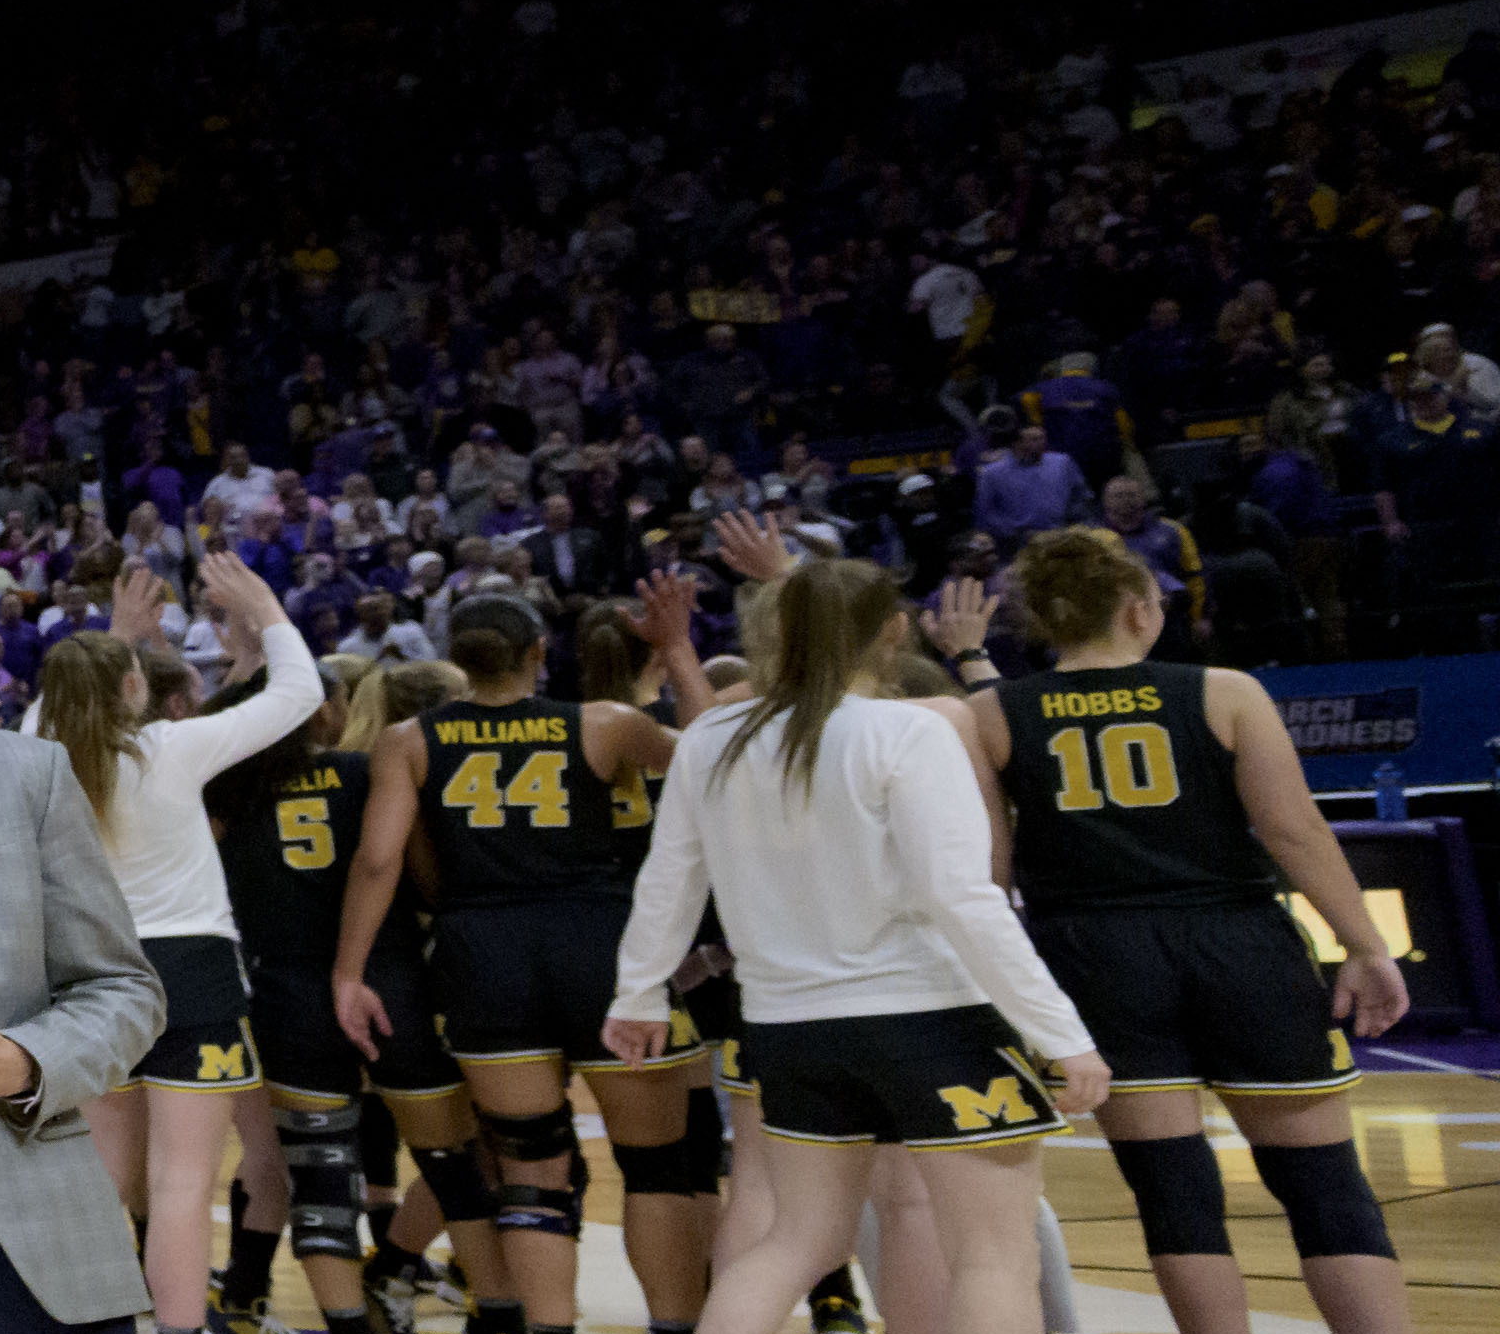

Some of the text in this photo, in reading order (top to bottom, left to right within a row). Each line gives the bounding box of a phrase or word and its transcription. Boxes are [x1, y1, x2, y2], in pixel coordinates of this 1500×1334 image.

[1041, 686, 1163, 719] HOBBS
[435, 717, 567, 745] WILLIAMS
[441, 751, 570, 828] 44
[1048, 722, 1181, 812] 10
[277, 798, 336, 870] 5
[198, 1043, 244, 1080] M
[938, 1076, 1037, 1132] M
